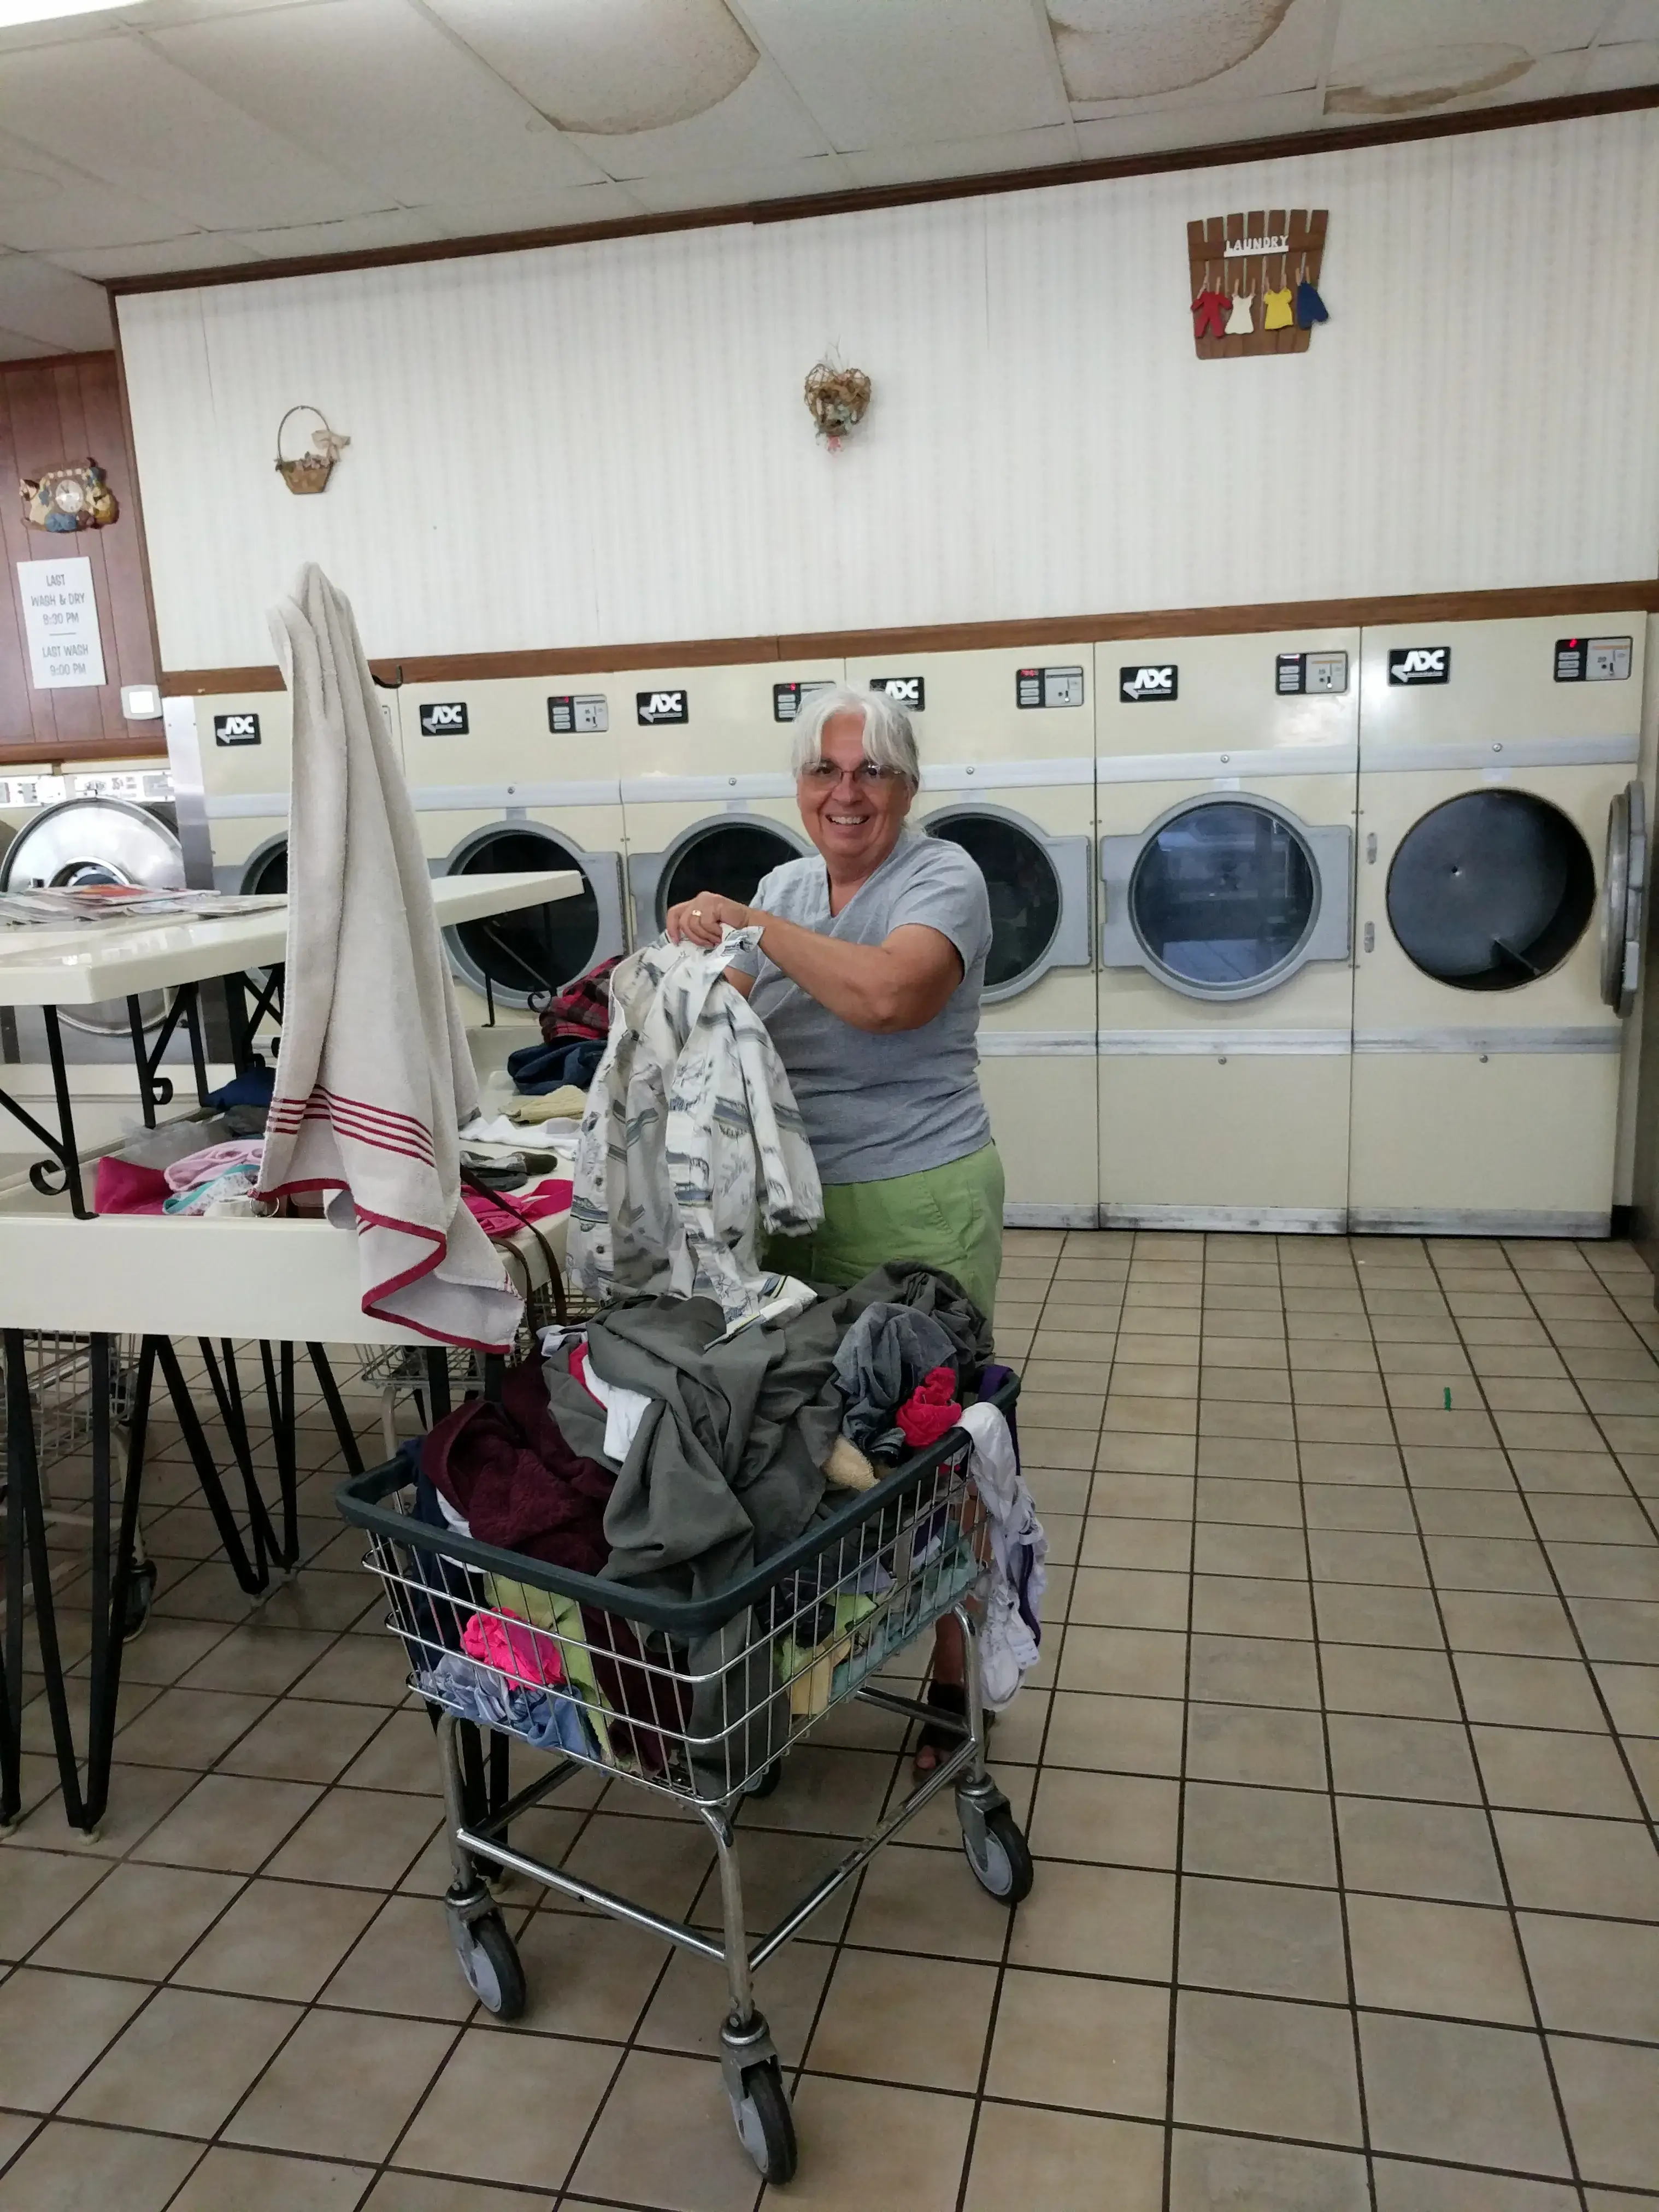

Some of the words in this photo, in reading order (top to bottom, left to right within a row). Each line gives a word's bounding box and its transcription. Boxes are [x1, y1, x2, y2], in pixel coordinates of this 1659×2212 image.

[1225, 235, 1289, 252] LAUNDRY
[46, 574, 66, 587] LAST
[31, 595, 56, 607] WASH
[59, 593, 66, 605] &
[68, 592, 85, 604] DRY
[43, 613, 63, 626] 8:30
[66, 611, 80, 624] PM
[42, 645, 61, 658] LAST
[63, 644, 89, 657] WASH
[1403, 649, 1445, 672] ADC
[50, 663, 70, 677] 9:00
[73, 663, 87, 675] PM
[1134, 667, 1172, 689] ADC
[885, 679, 919, 700] ADC
[649, 693, 682, 713] ADC
[432, 705, 463, 724] ADC
[226, 716, 255, 734] ADC
